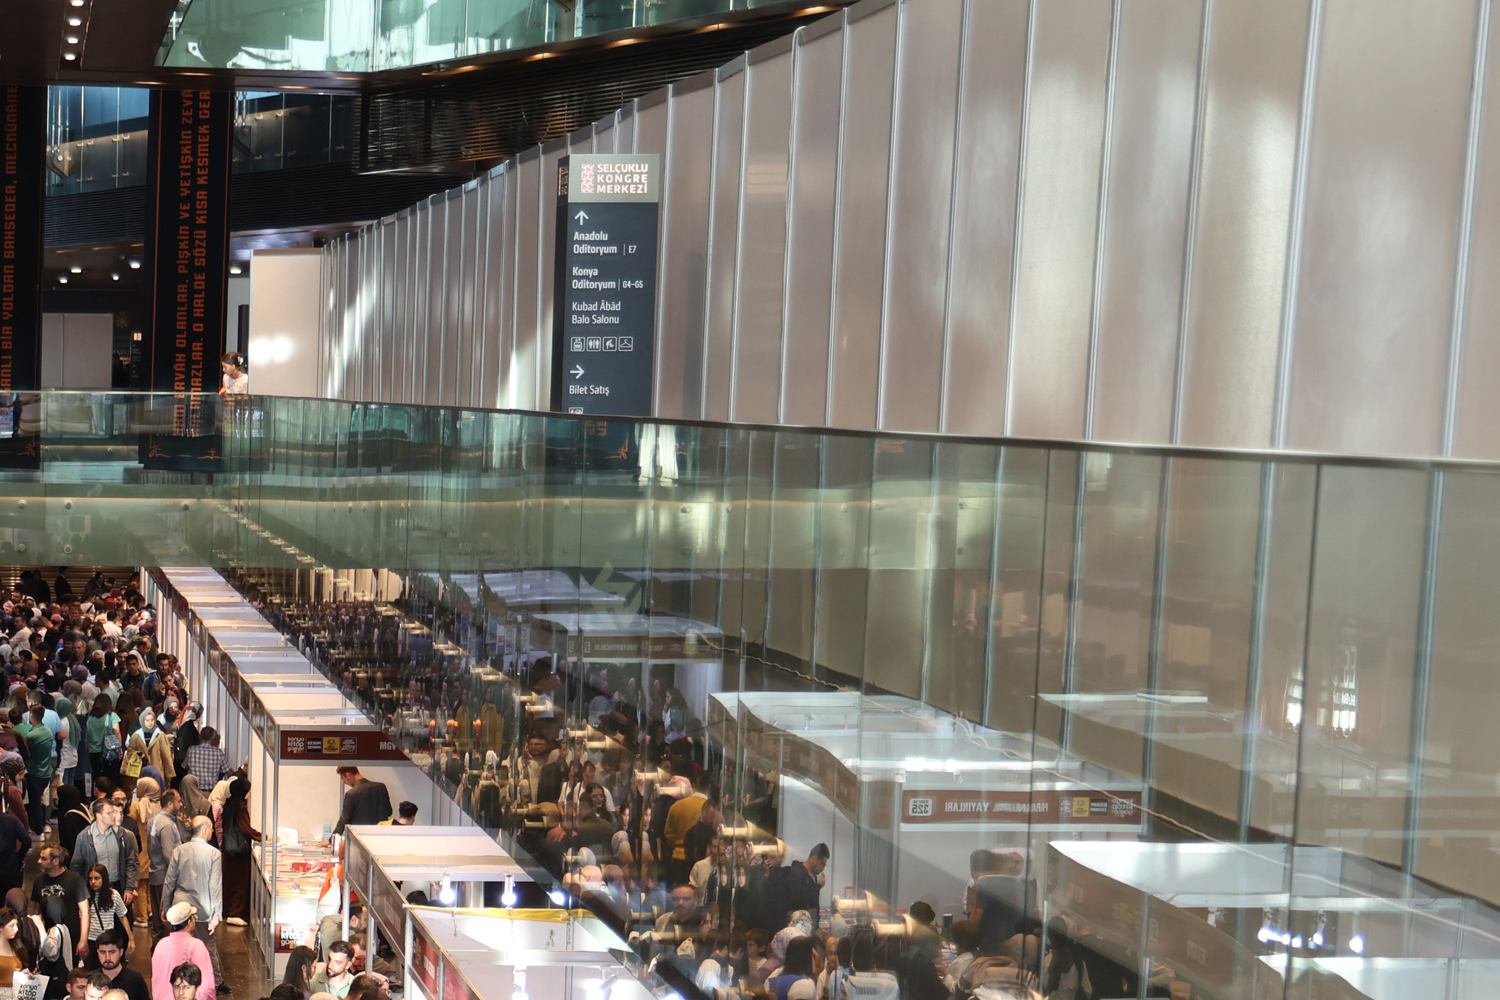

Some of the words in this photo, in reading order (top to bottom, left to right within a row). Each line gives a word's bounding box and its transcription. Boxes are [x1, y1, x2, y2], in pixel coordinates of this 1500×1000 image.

[179, 131, 194, 197] YETİŞKİN
[196, 125, 210, 185] KESMEK
[597, 163, 649, 175] SELÇUKLU
[597, 174, 648, 183] KONGRE
[596, 183, 648, 194] MERKEZİ
[180, 202, 190, 220] VE
[195, 190, 209, 224] KISA
[3, 180, 18, 259] BAHSEDER,
[573, 231, 608, 241] Anadolu
[176, 226, 192, 274] PİŞKİN
[192, 230, 207, 267] SÖZÜ
[573, 244, 617, 256] Oditoryum
[628, 245, 637, 253] E7
[572, 267, 598, 278] Konya
[2, 265, 14, 321] YOLDAN
[572, 279, 616, 291] Oditoryum
[193, 273, 206, 317] HALDE
[175, 280, 190, 348] OLANLAR,
[572, 301, 598, 311] Kubad
[571, 315, 590, 324] Balo
[591, 315, 620, 324] Salonu
[0, 326, 13, 350] BİR
[569, 385, 587, 395] Bilet
[589, 385, 610, 396] Satış
